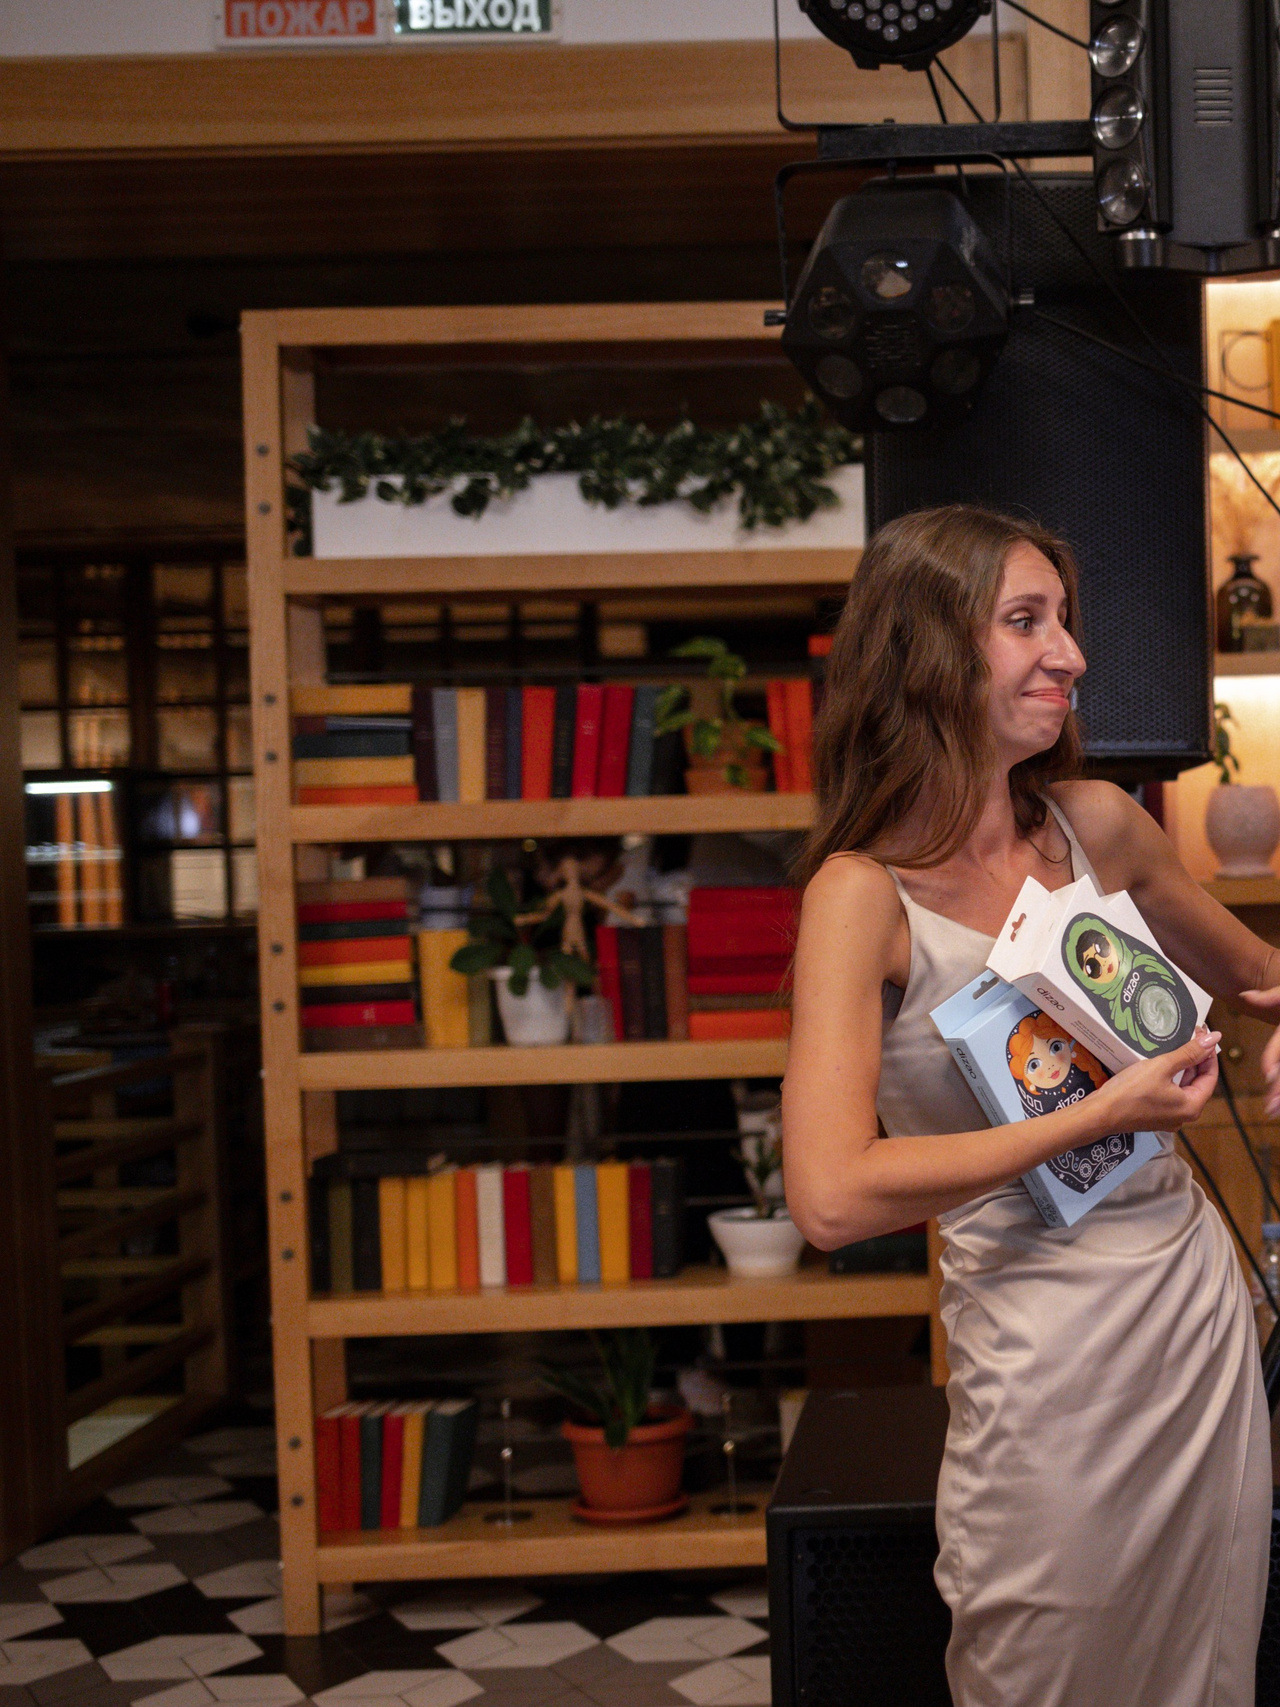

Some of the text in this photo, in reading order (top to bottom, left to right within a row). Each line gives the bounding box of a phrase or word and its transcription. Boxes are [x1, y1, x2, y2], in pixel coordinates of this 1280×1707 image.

[231, 2, 371, 35] ПОЖАР
[409, 0, 541, 32] ВЫХОД
[1036, 987, 1065, 1011] dizao
[1123, 971, 1140, 1004] dizao
[956, 1047, 977, 1079] dizao
[1055, 1087, 1085, 1111] dizao
